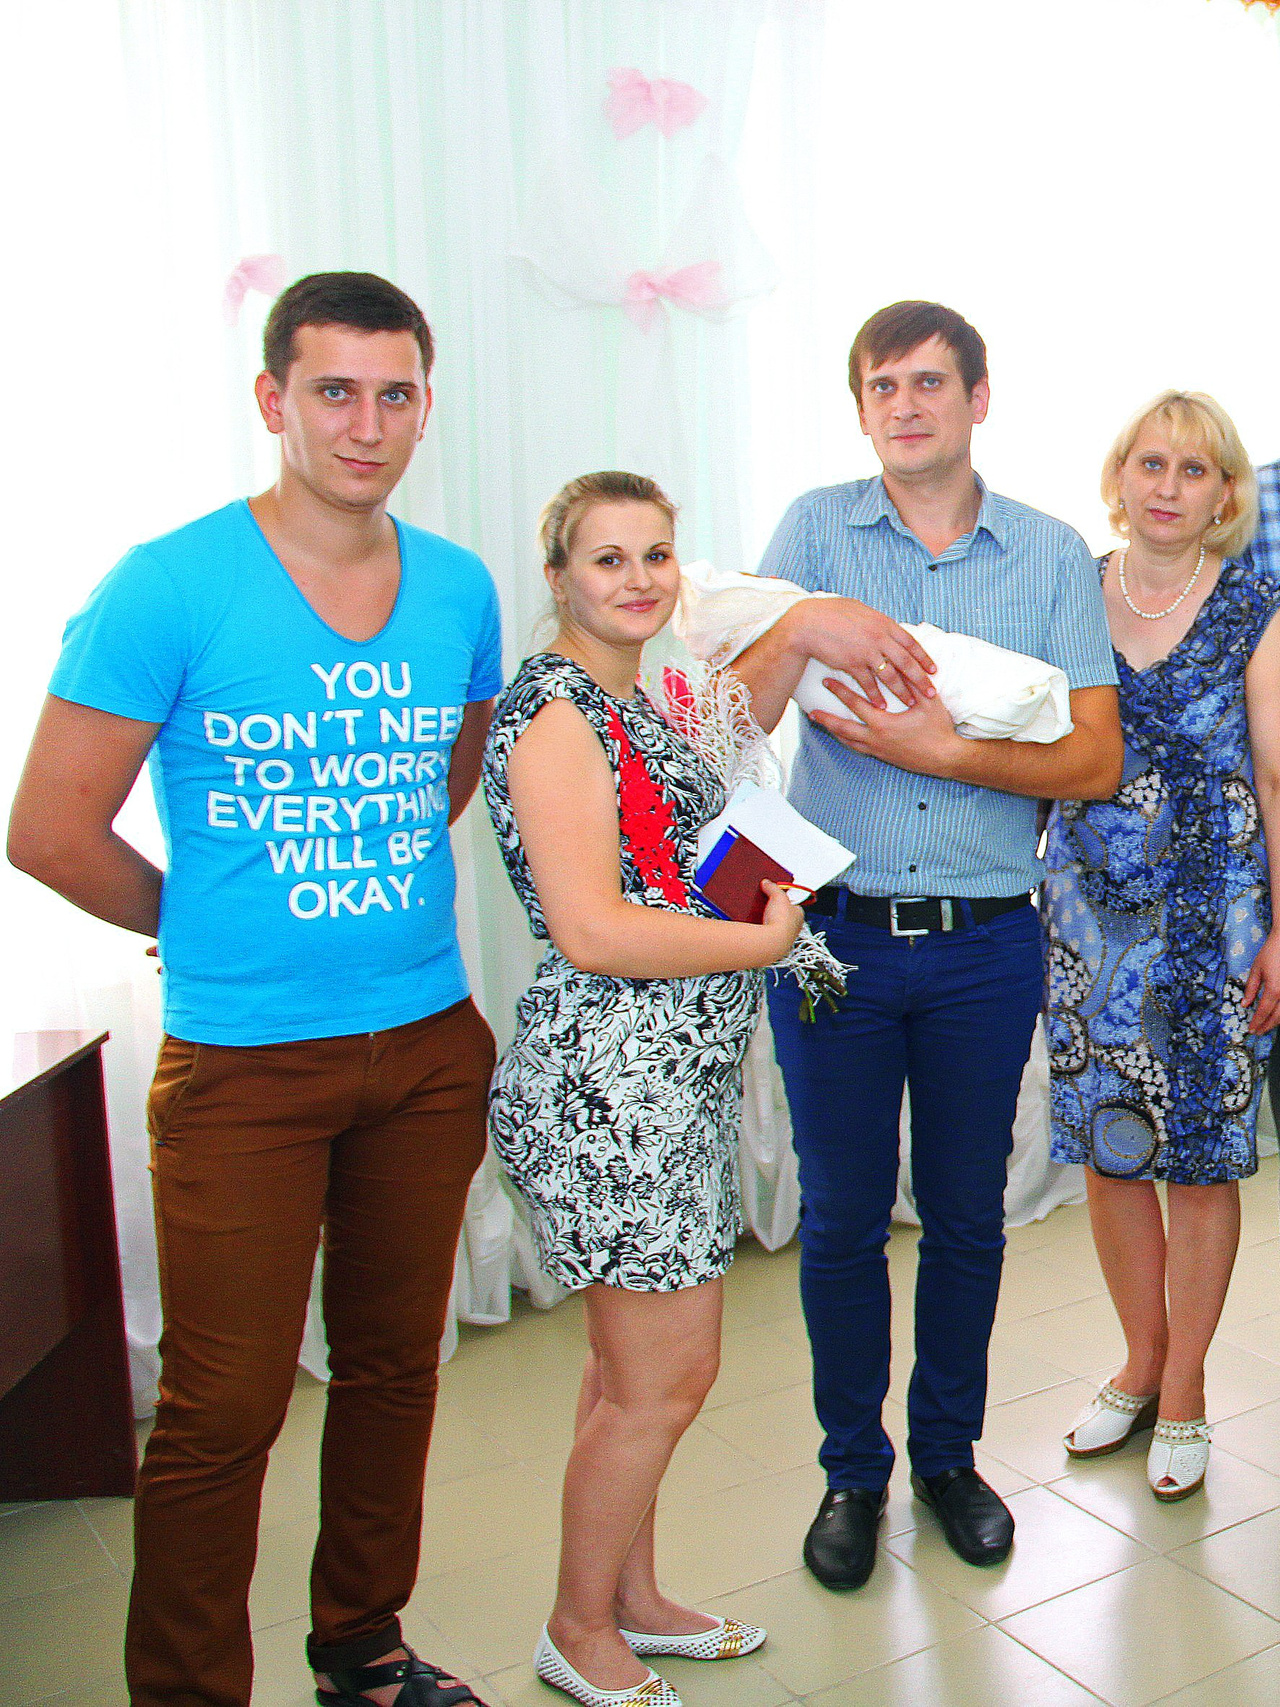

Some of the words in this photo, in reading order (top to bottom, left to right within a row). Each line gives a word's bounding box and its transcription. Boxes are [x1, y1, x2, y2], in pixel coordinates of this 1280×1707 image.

[310, 661, 412, 700] YOU
[204, 709, 364, 751] DON'T
[223, 754, 295, 791] TO
[265, 835, 377, 874] WILL
[388, 828, 433, 866] BE
[288, 872, 426, 920] OKAY.
